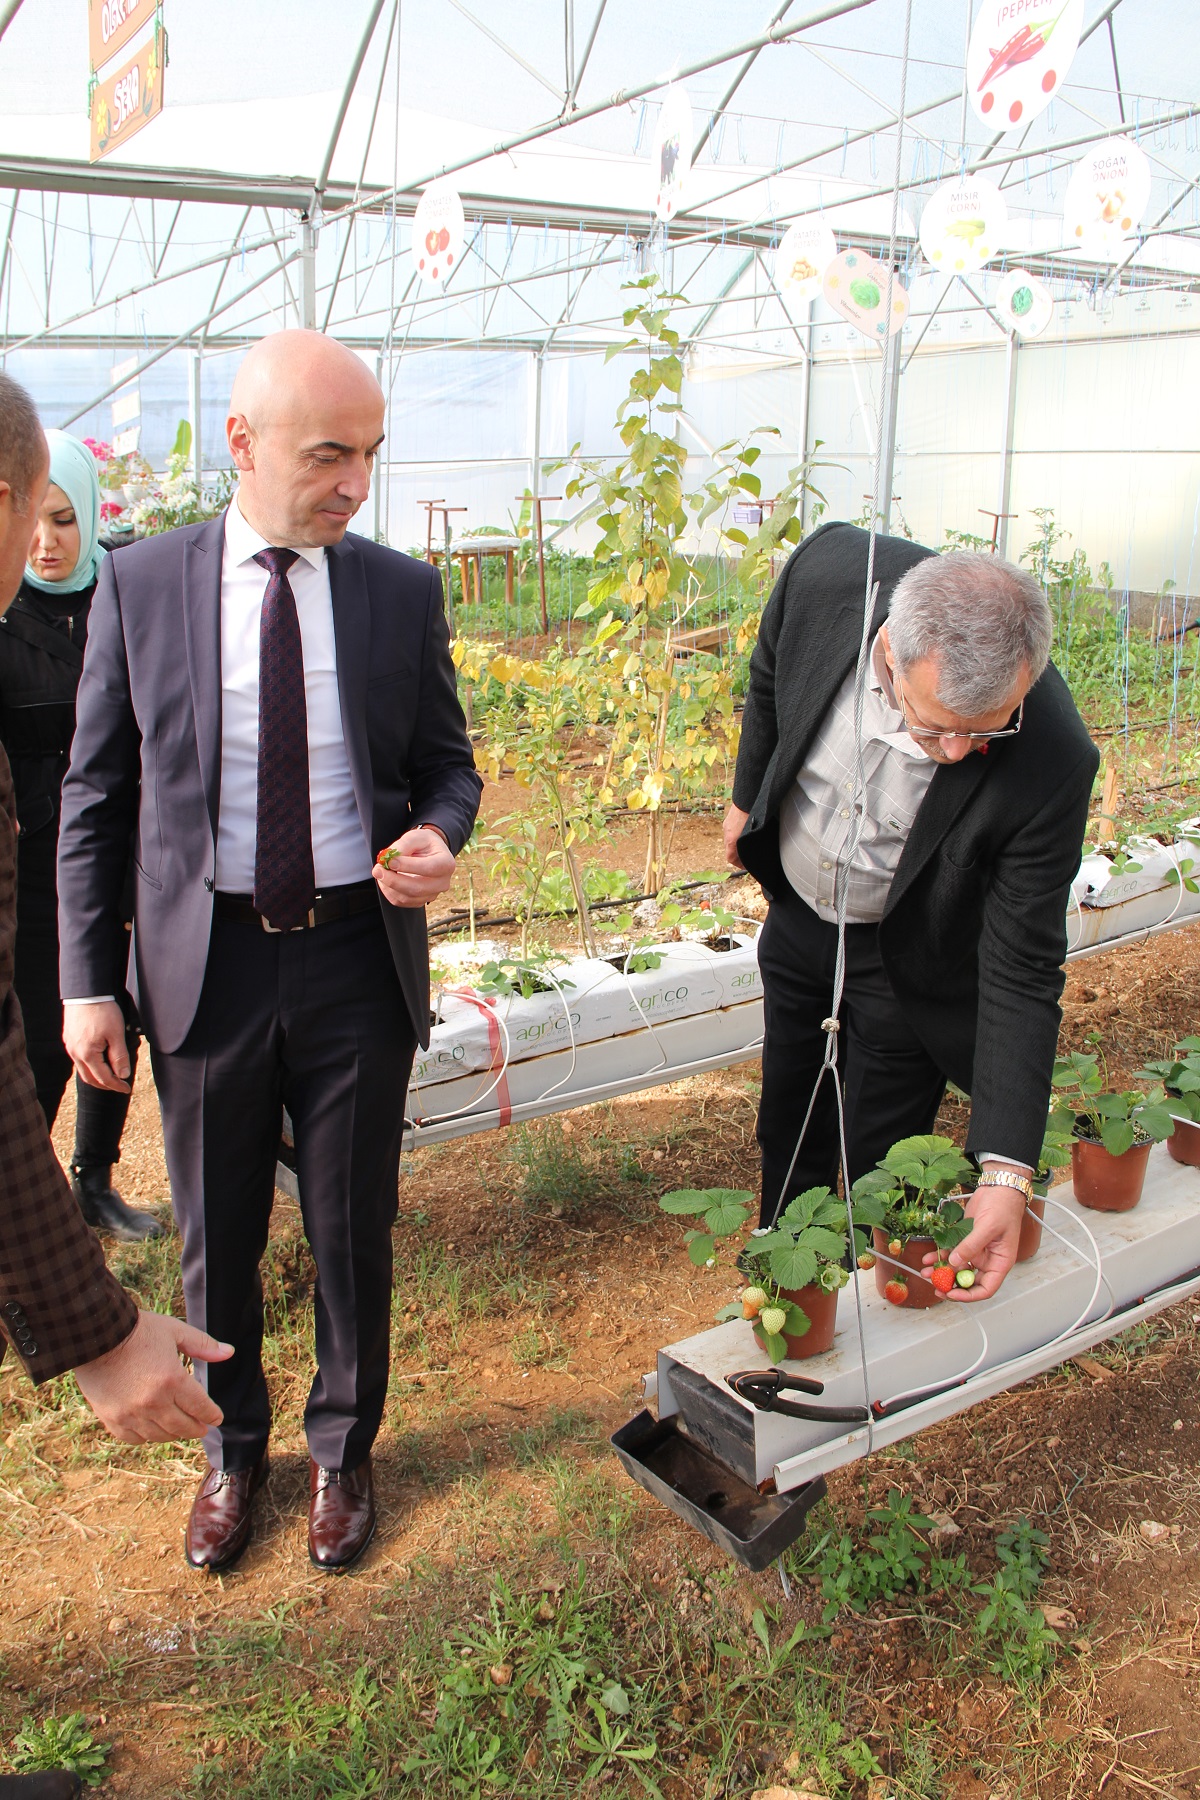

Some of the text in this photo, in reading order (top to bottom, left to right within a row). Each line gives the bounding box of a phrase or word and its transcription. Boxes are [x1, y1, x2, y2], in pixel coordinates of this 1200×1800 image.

[113, 64, 140, 133] SERA
[1092, 156, 1127, 171] SOĞAN
[947, 201, 981, 215] (CORN)
[628, 986, 689, 1012] agrico
[515, 1012, 581, 1042] agrico
